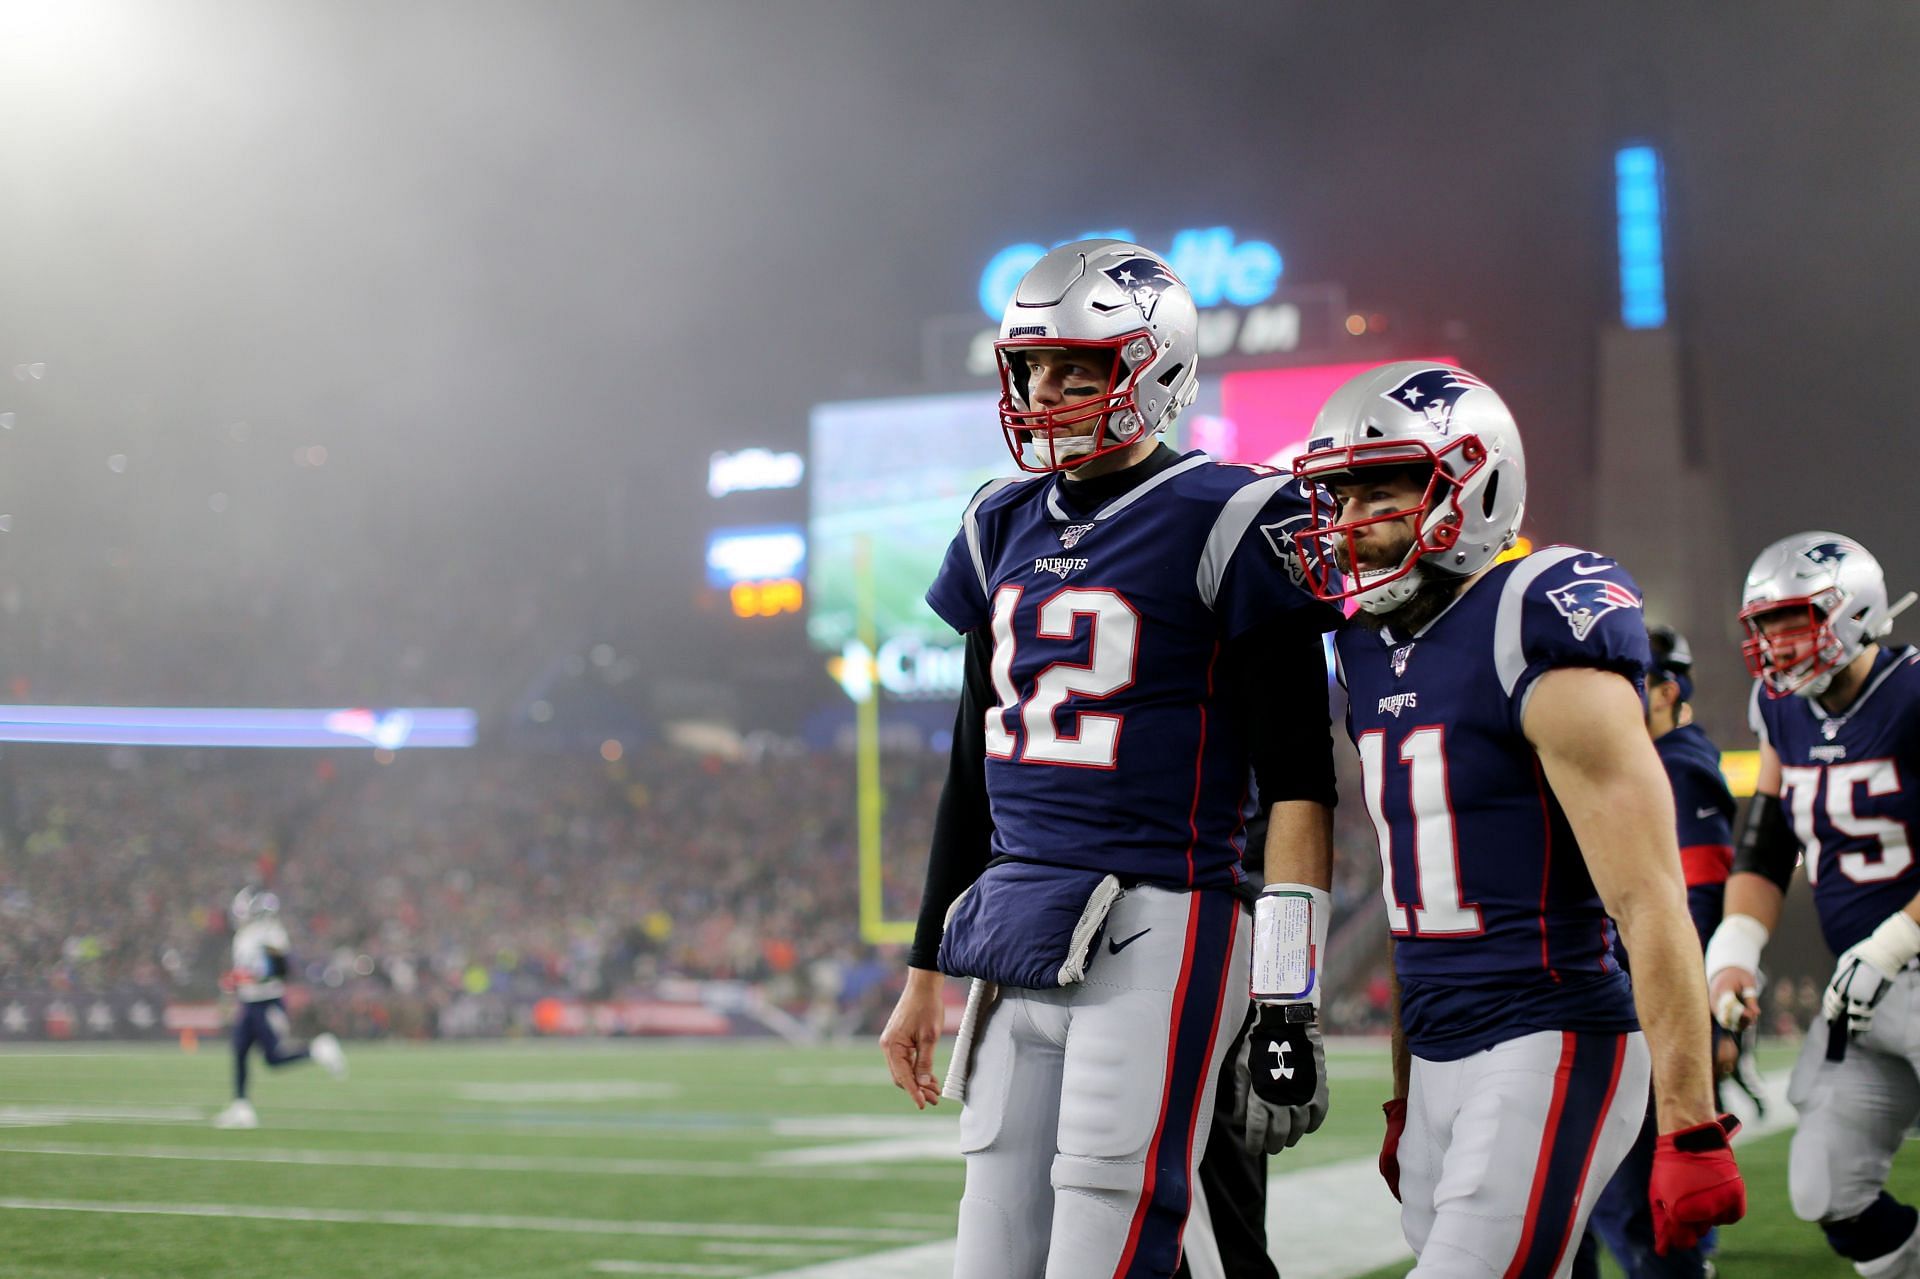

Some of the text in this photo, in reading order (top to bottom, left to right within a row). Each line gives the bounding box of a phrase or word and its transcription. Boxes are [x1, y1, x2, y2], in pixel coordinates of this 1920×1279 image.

[1033, 557, 1089, 574] PATRIOTS
[986, 584, 1142, 771] 12
[1378, 692, 1417, 715] PATRIOTS
[1357, 724, 1486, 938] 11
[1780, 757, 1914, 887] 75
